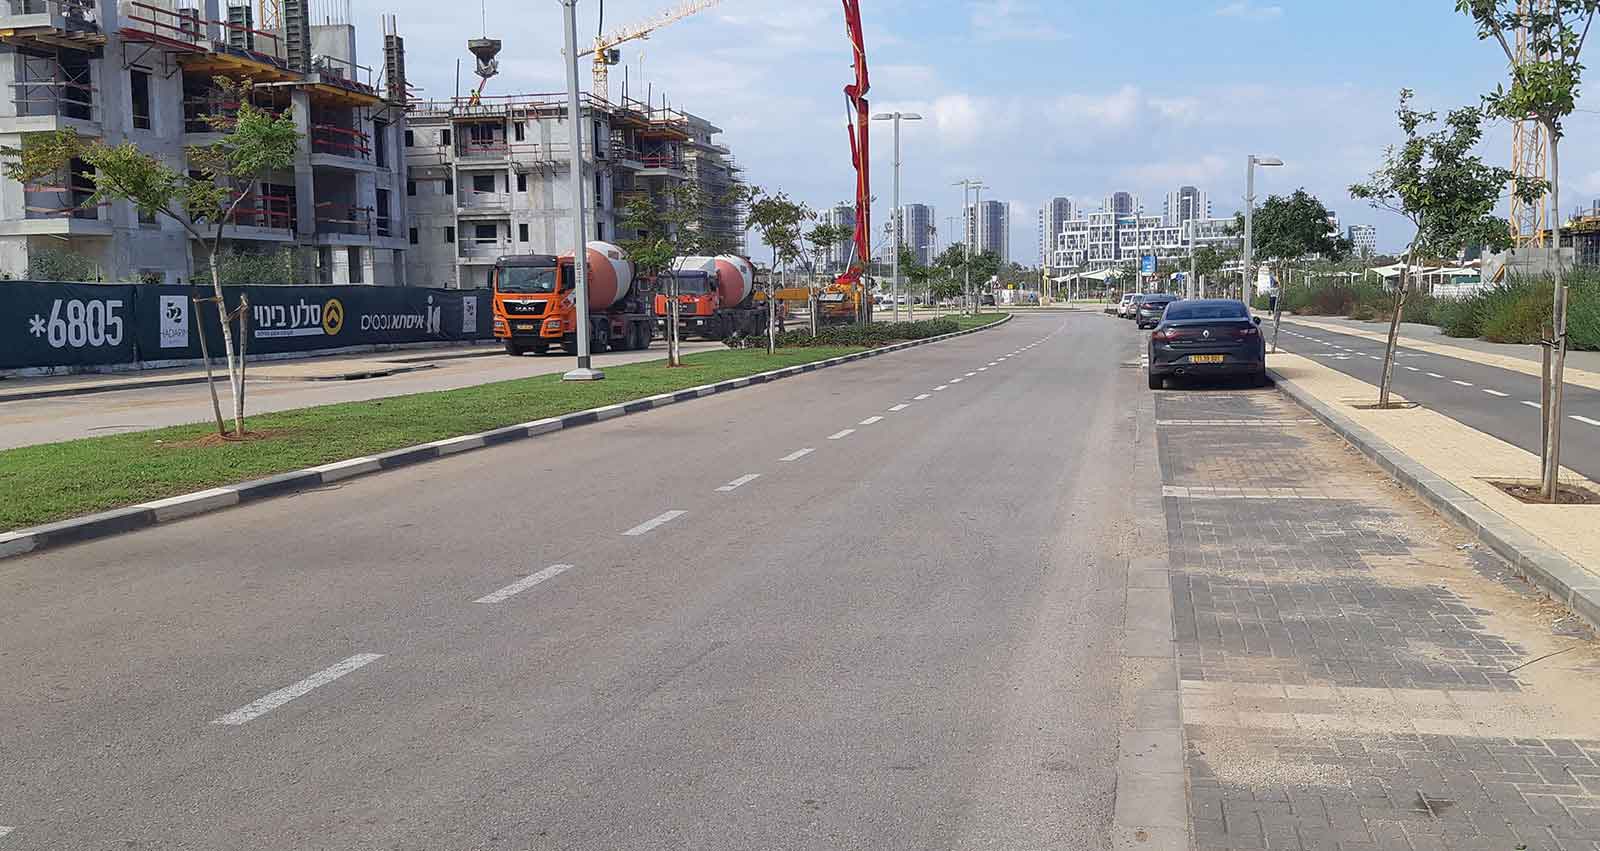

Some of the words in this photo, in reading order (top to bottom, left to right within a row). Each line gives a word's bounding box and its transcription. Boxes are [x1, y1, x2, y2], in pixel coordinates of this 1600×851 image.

[166, 302, 182, 323] 52
[254, 305, 287, 327] בינוי
[290, 298, 321, 328] סלע
